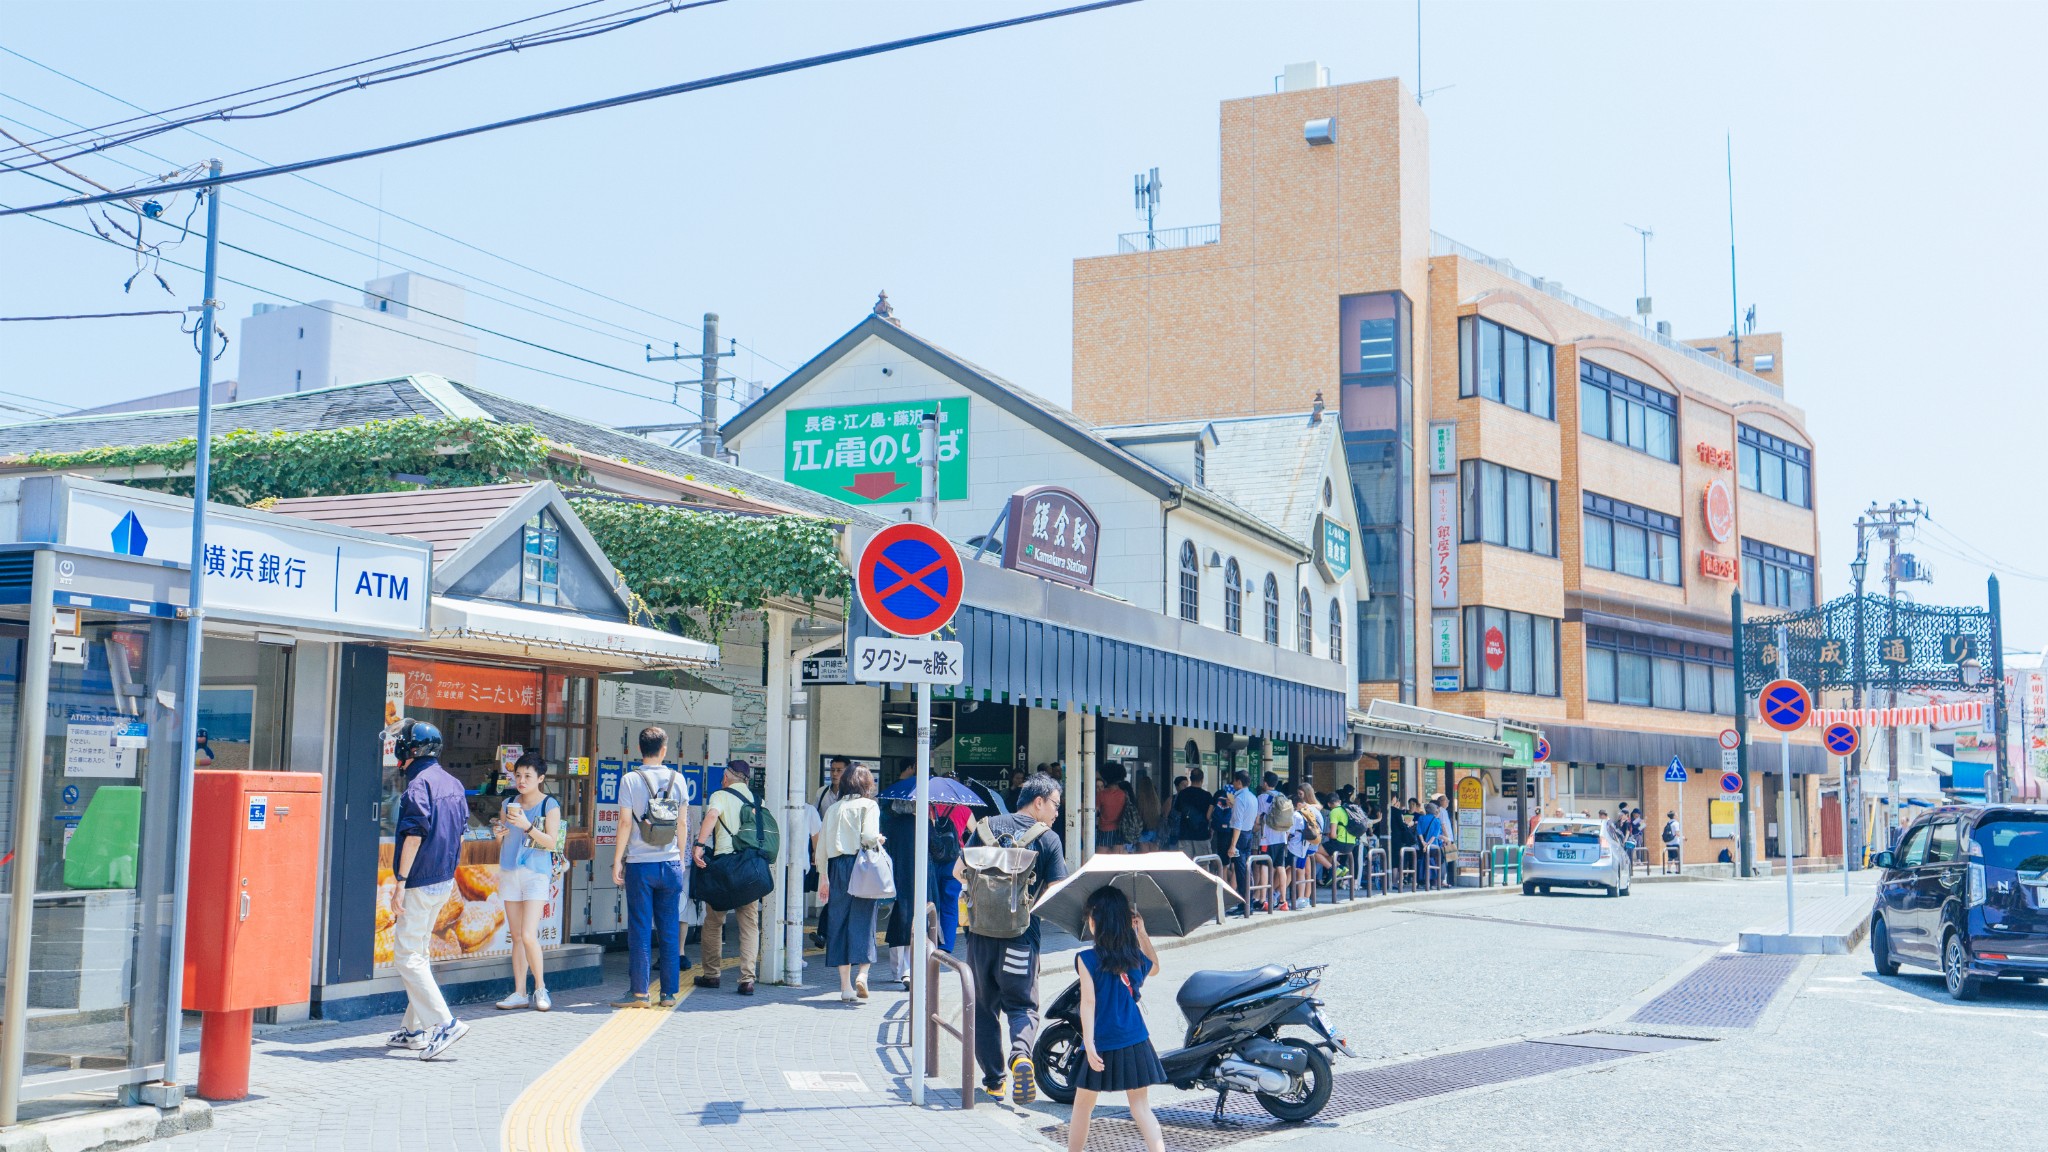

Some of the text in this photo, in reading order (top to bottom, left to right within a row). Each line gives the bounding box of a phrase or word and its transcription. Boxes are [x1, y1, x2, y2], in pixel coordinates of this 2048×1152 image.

[805, 409, 948, 432] 長谷・江ノ島・藤沢面
[792, 429, 964, 471] 江ノ電のりば
[1032, 500, 1088, 555] 鎌倉駅
[203, 543, 307, 589] 横浜銀行
[1034, 547, 1066, 569] Kamakura
[1066, 557, 1088, 576] Station
[1437, 525, 1451, 601] 銀座アスター
[59, 577, 73, 585] NTT
[354, 570, 409, 601] ATM
[861, 648, 958, 676] タクシーを除く
[1761, 635, 1969, 666] 御成通り
[468, 682, 543, 707] ミニたい焼き
